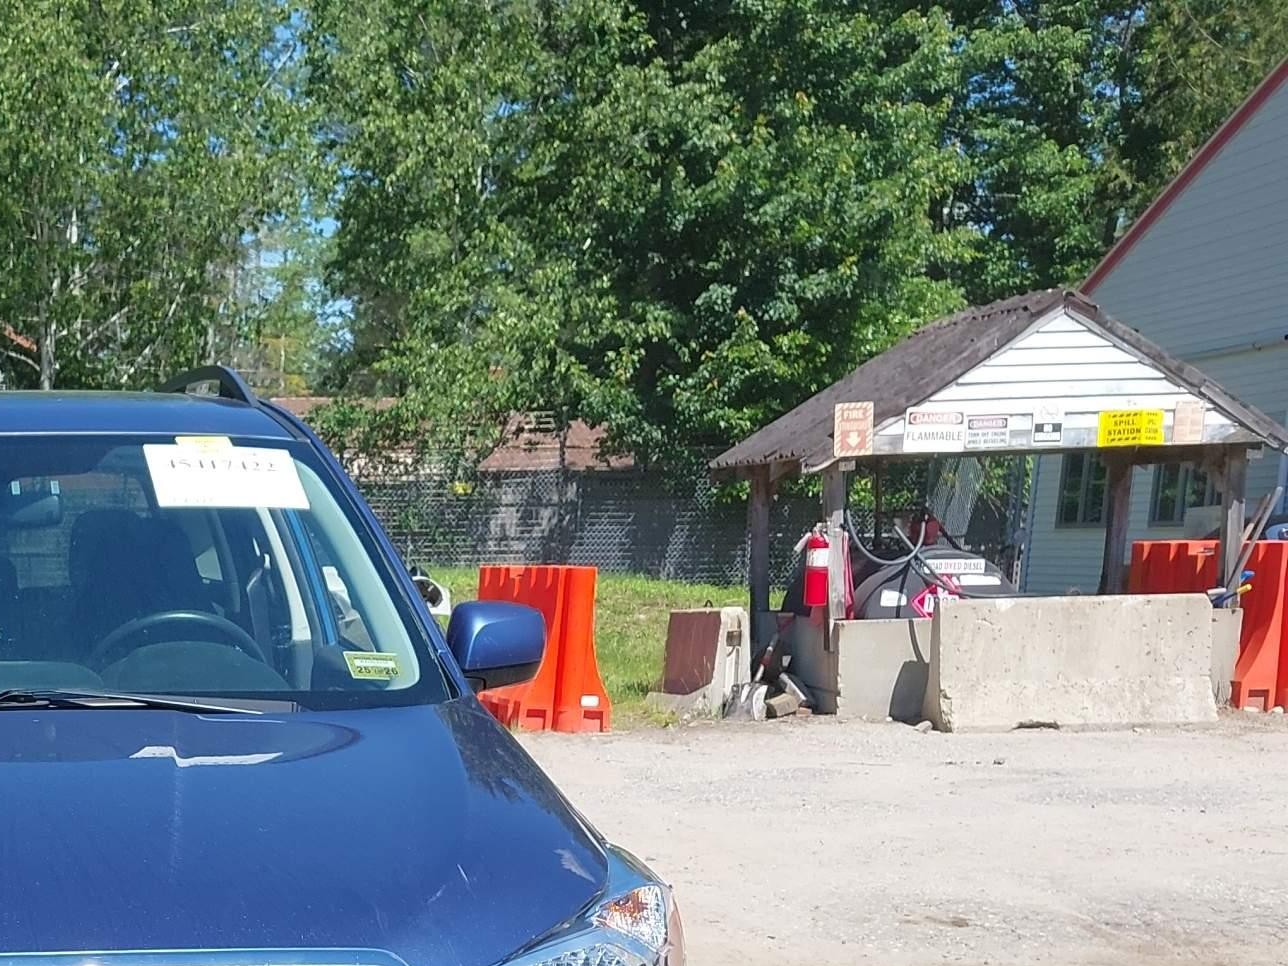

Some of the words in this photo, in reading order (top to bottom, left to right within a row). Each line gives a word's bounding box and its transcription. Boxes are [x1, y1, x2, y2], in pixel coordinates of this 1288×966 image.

[917, 412, 956, 424] DANGER
[1113, 419, 1136, 427] SPILL
[1107, 427, 1141, 436] STATION
[906, 431, 962, 441] FLAMMABLE
[963, 562, 983, 570] DIESEL
[356, 666, 371, 674] 25
